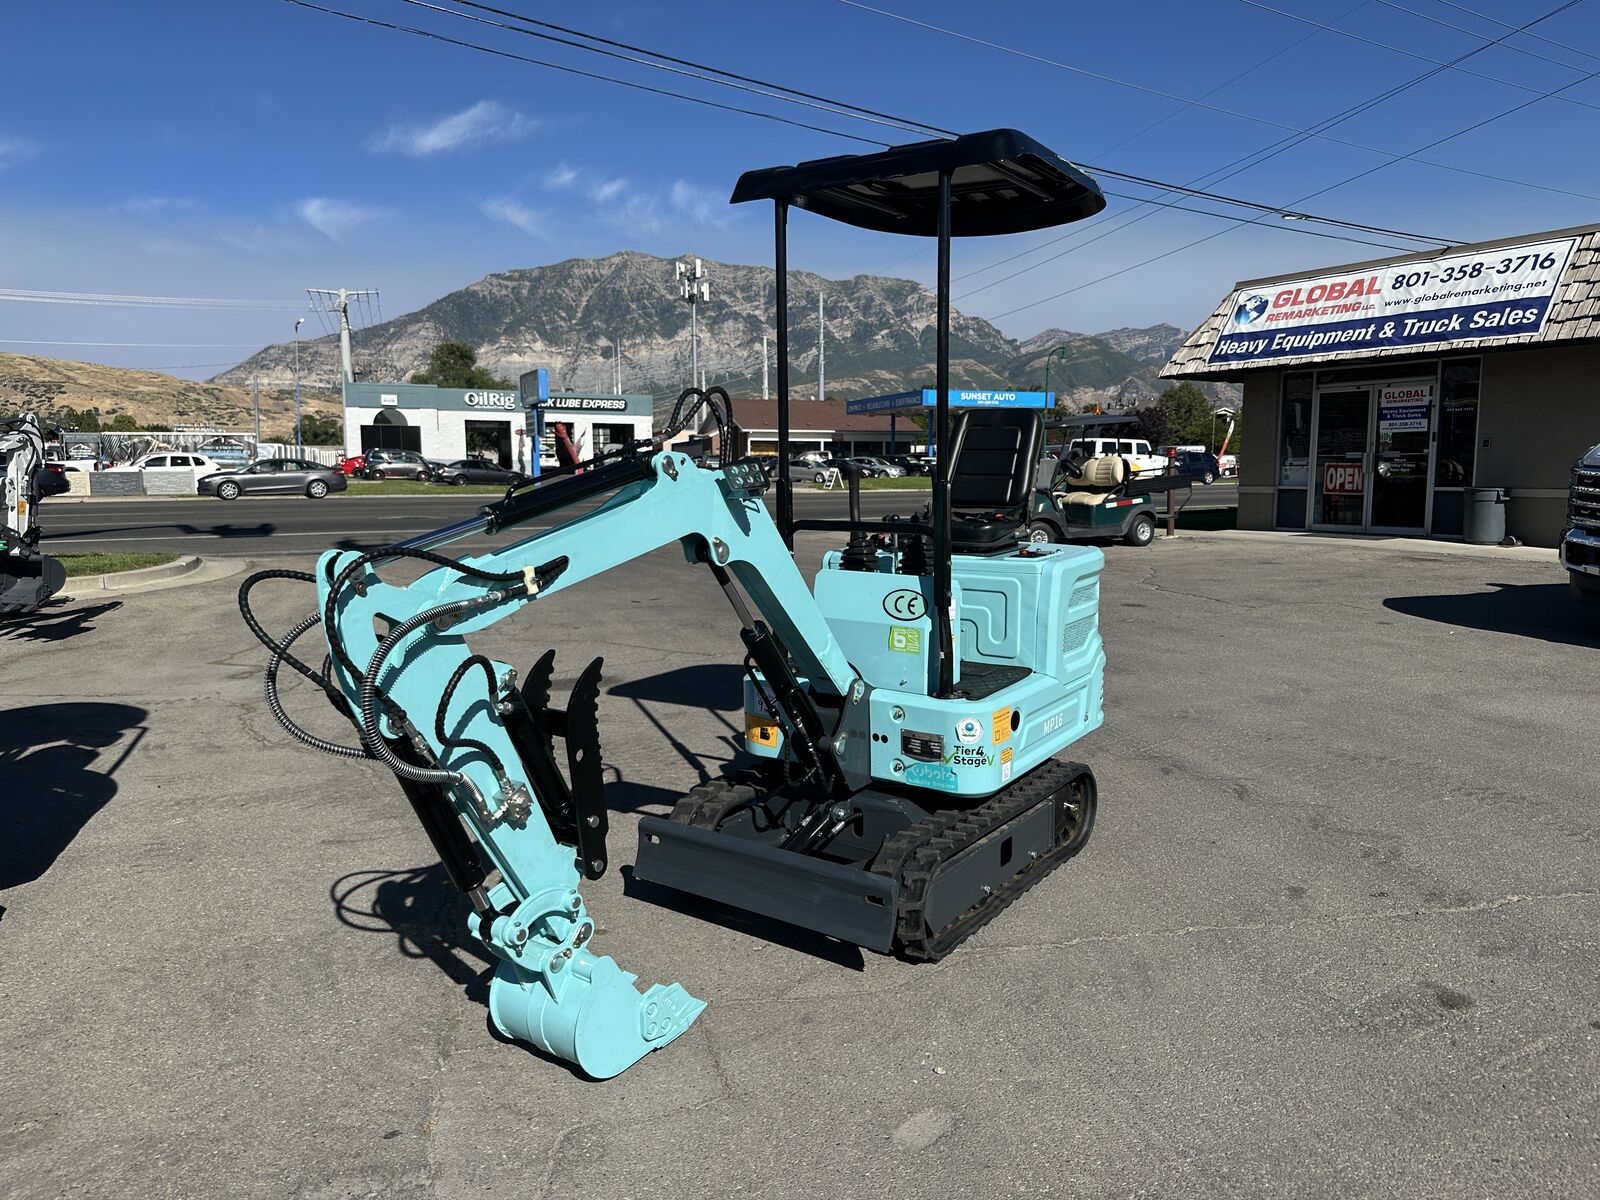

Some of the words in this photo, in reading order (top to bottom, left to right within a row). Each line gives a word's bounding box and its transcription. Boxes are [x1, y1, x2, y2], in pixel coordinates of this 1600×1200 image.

[1391, 252, 1556, 290] 801-358-3716
[1272, 276, 1382, 308] GLOBAL
[1384, 280, 1548, 306] www.globalremarketing.net
[1265, 302, 1362, 322] REMARKETING
[1215, 338, 1270, 355] Heavy
[1271, 323, 1376, 351] Equipment
[1379, 322, 1395, 338] &
[1402, 314, 1465, 336] Truck
[1470, 307, 1538, 328] Sales
[464, 391, 516, 410] OilRig
[556, 398, 581, 408] LUBE
[582, 399, 626, 409] EXPRESS
[960, 392, 992, 400] SUNSET
[993, 393, 1016, 401] AUTO
[1384, 390, 1426, 399] GLOBAL
[1327, 467, 1363, 490] OPEN
[894, 595, 918, 615] CE
[1043, 712, 1064, 736] MP16
